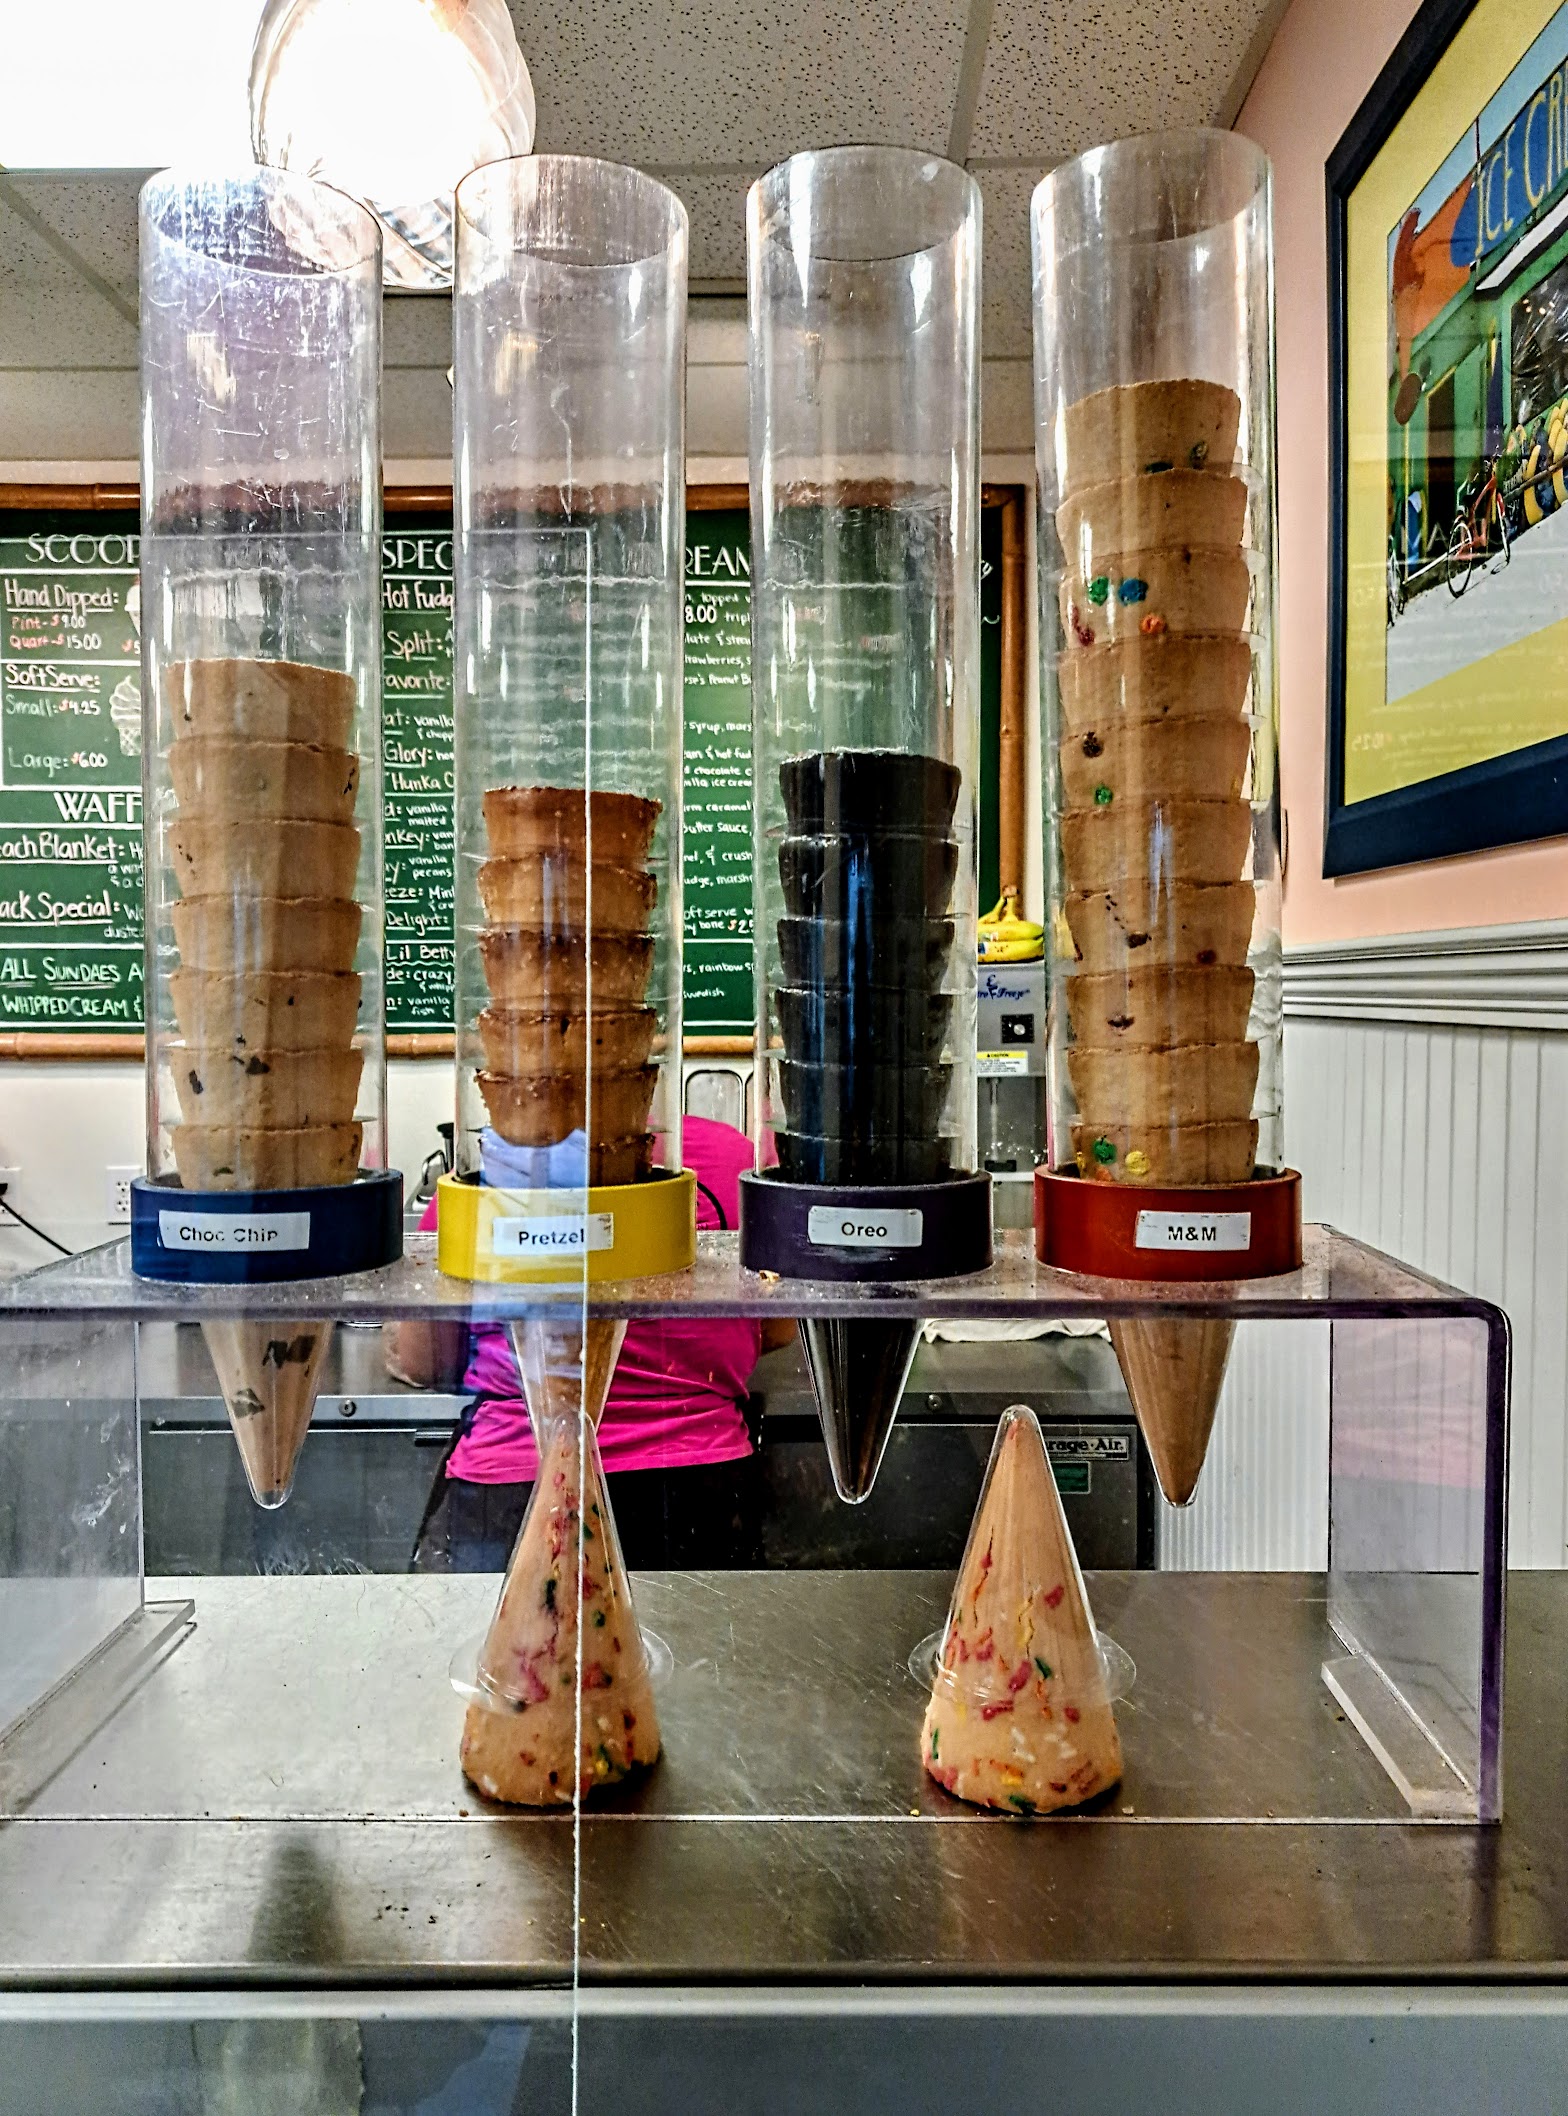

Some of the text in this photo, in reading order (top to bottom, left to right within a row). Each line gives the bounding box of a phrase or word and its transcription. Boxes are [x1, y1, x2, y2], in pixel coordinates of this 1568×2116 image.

[5, 578, 119, 616] Hand Dipped:
[6, 694, 59, 717] Small:
[8, 747, 68, 777] Large:
[53, 791, 142, 822] WAFF
[0, 833, 38, 858] ach
[38, 889, 120, 927] Special:
[705, 908, 737, 919] serve
[1, 957, 37, 981] ALL
[699, 962, 743, 974] rainbow
[2, 994, 69, 1015] WHIPPED
[70, 996, 130, 1018] CREAM
[179, 1226, 278, 1242] Choc Chip
[518, 1228, 584, 1245] Pretzel
[841, 1222, 888, 1237] Oreo
[1168, 1226, 1217, 1241] M&M
